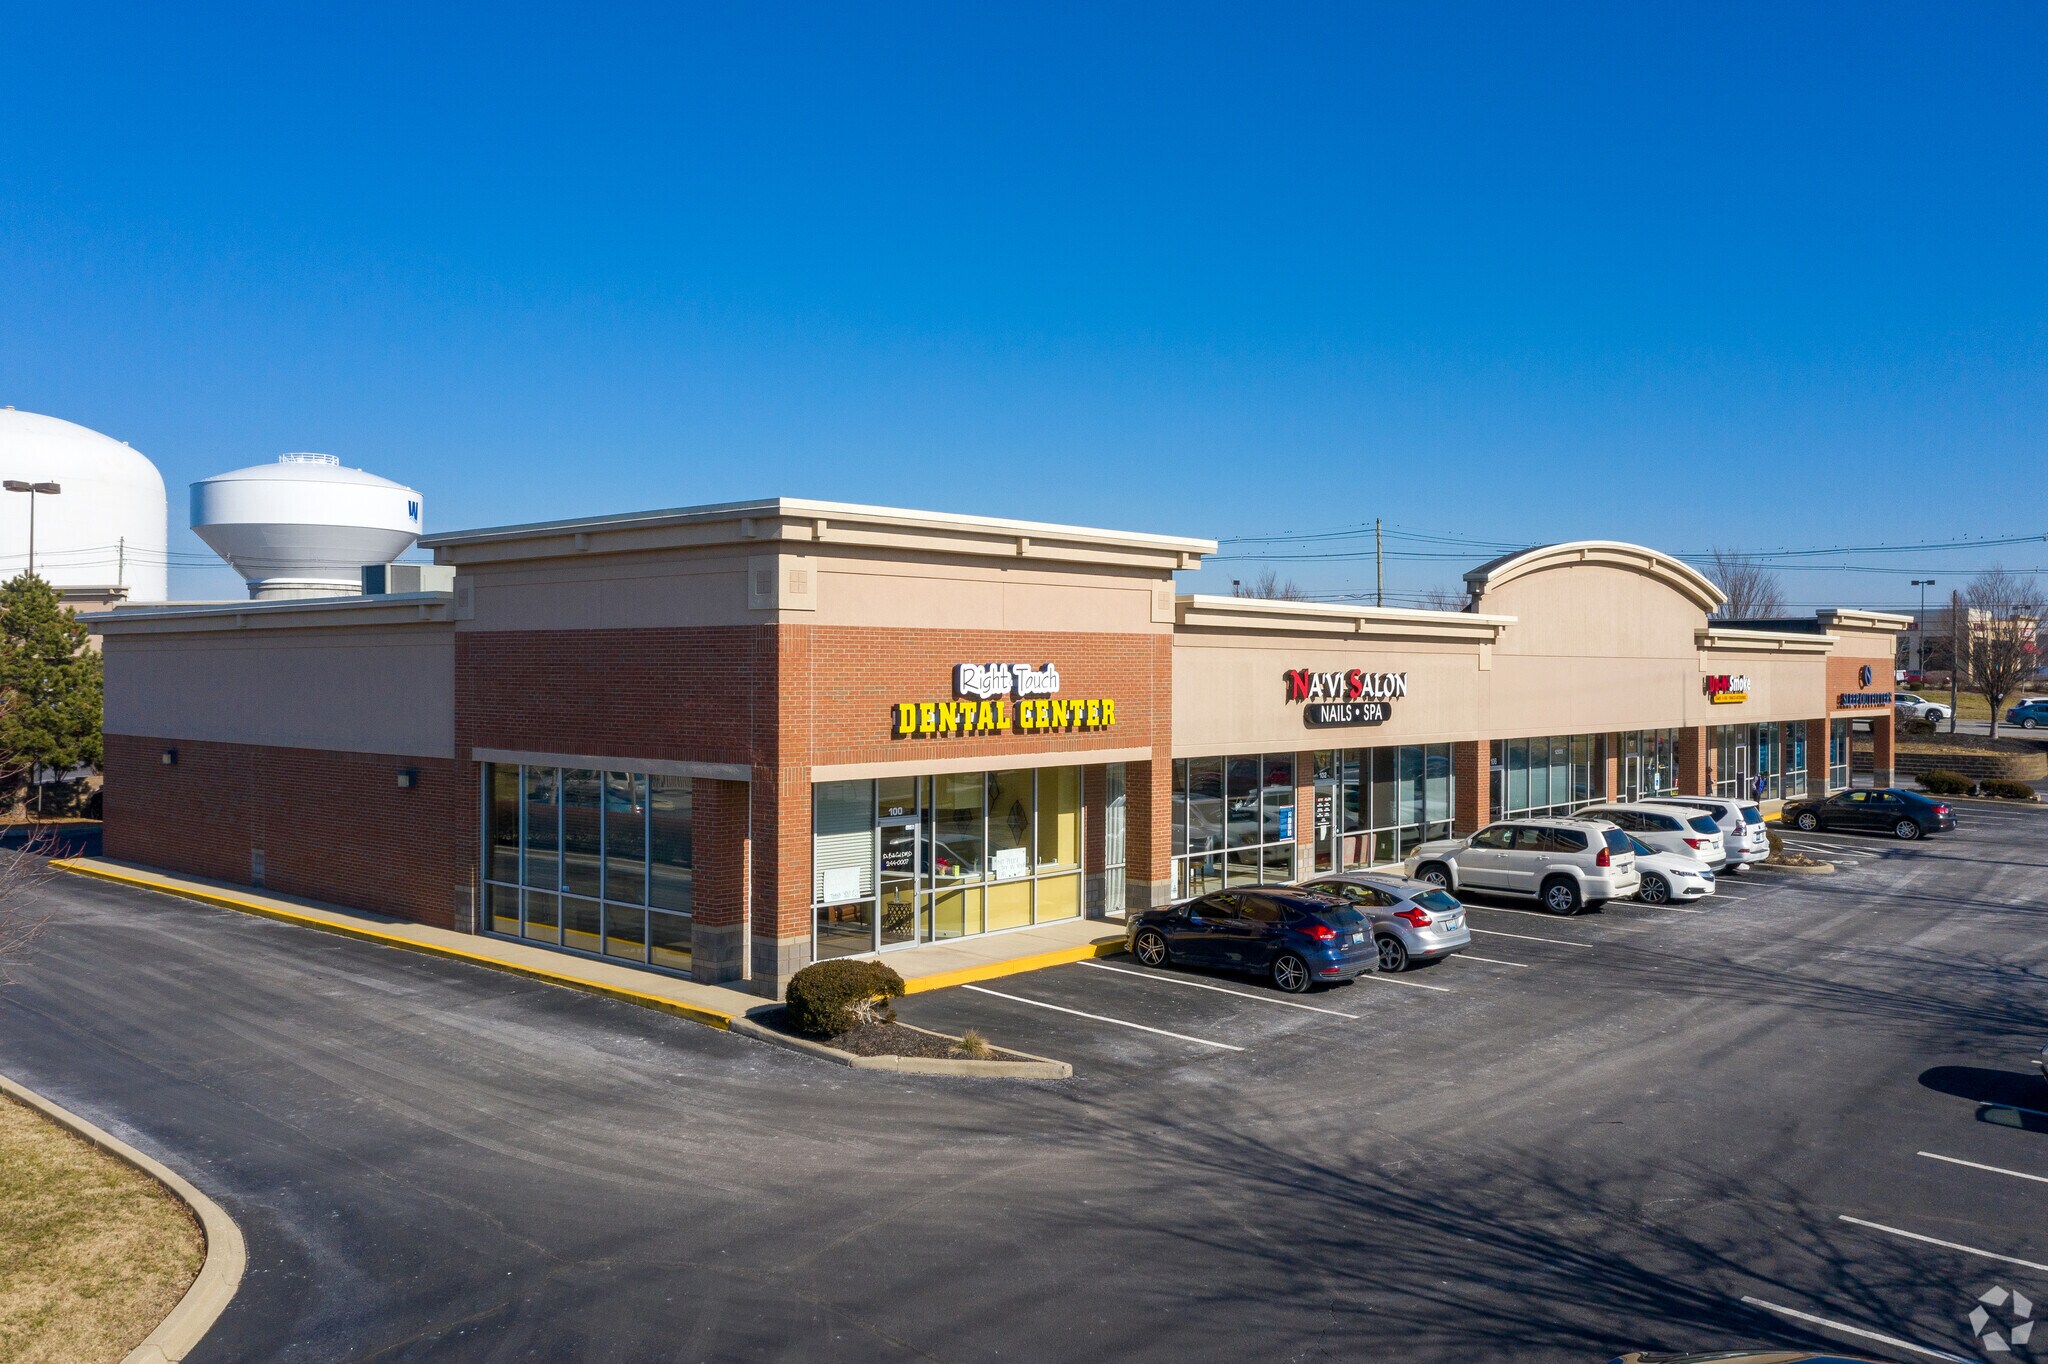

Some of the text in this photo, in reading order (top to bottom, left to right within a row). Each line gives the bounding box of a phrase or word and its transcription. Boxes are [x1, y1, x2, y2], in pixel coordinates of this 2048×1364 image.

[962, 666, 1058, 695] Right Touch
[1350, 668, 1408, 699] SALON
[899, 698, 1116, 734] DENTAL CENTER
[1320, 703, 1383, 723] NAILS SPA
[888, 806, 903, 816] 100
